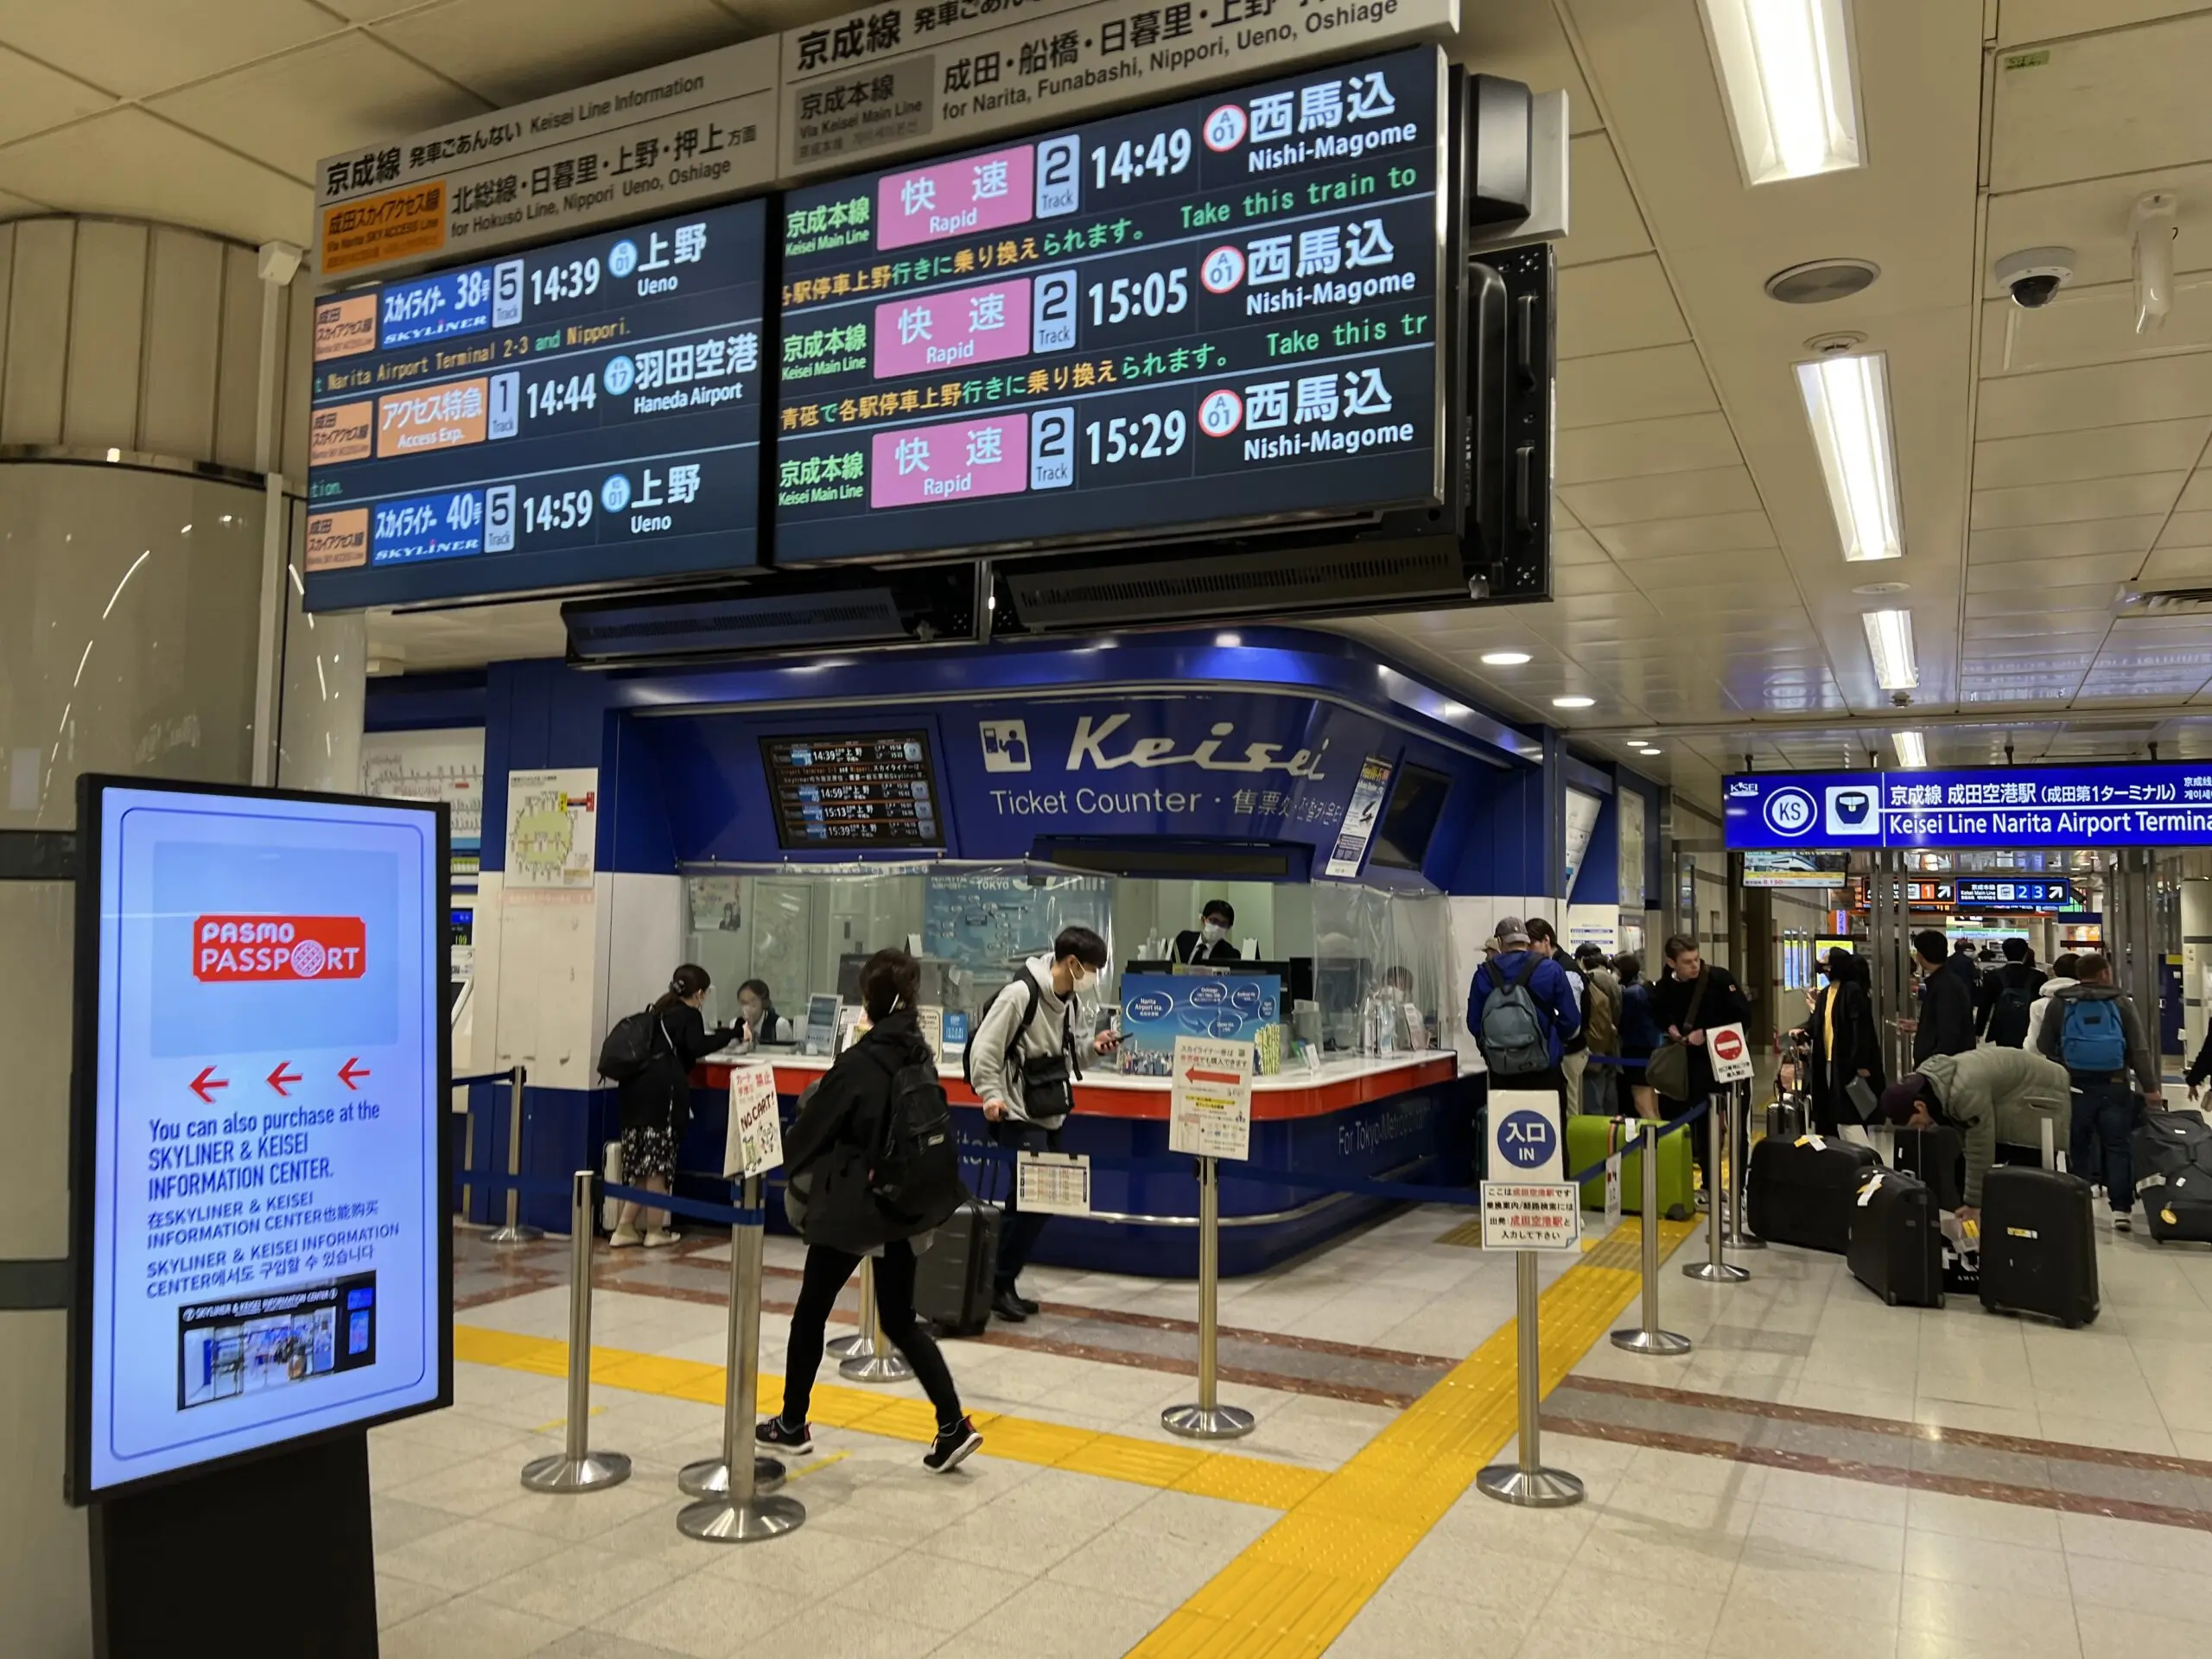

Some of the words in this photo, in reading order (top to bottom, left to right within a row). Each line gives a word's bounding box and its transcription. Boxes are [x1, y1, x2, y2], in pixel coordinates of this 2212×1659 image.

[798, 10, 901, 71] 京成線
[942, 100, 968, 120] for
[973, 87, 1032, 114] Narita,
[1038, 57, 1143, 99] Funabashi,
[1149, 36, 1229, 72] Nippori,
[1236, 22, 1297, 51] Ueno,
[1306, 0, 1398, 33] Oshiage
[531, 107, 574, 133] Keisei
[579, 99, 610, 121] Line
[614, 75, 704, 112] Information
[800, 73, 894, 120] 京成本線
[862, 107, 893, 124] Main
[895, 101, 923, 117] Line
[1249, 71, 1395, 143] 西馬込
[1212, 124, 1235, 143] 01
[1219, 110, 1230, 123] A
[327, 147, 401, 196] 京成線
[410, 122, 522, 169] 発車ごあんない
[1091, 127, 1192, 190] 14:49
[1248, 120, 1418, 173] Nishi-Magome
[1045, 145, 1071, 187] 2
[328, 188, 441, 236] 成田スカイアクセス線
[451, 219, 469, 238] for
[527, 199, 559, 219] Line,
[622, 175, 664, 197] Ueno,
[669, 159, 731, 186] Oshiage
[1041, 188, 1073, 211] Track
[1180, 201, 1230, 230] Take
[1243, 188, 1294, 217] this
[1306, 173, 1375, 206] train
[1389, 166, 1417, 189] to
[787, 195, 870, 238] 京成本線
[929, 207, 977, 234] Rapid
[638, 222, 707, 272] 上野
[785, 238, 817, 257] Keisei
[817, 232, 843, 252] Main
[845, 227, 870, 246] Line
[1218, 252, 1229, 264] A
[1247, 218, 1395, 287] 西馬込
[499, 268, 517, 301] 5
[531, 257, 601, 305] 14:39
[637, 276, 678, 297] Ueno
[1210, 264, 1234, 285] 01
[384, 284, 446, 324] スカイライナー
[454, 270, 491, 310] 38号
[1042, 279, 1068, 321] 2
[1089, 266, 1188, 327] 15:05
[1246, 270, 1417, 316] Nishi-Magome
[496, 306, 518, 321] Track
[783, 321, 868, 364] 京成本線
[926, 340, 975, 365] Rapid
[1039, 327, 1071, 345] Track
[1266, 329, 1319, 358] Take
[1332, 318, 1386, 346] this
[1401, 313, 1427, 336] tr
[328, 370, 372, 390] Narita
[377, 355, 429, 383] Airport
[435, 341, 495, 369] Terminal
[535, 329, 561, 352] and
[566, 316, 632, 346] Nippori.
[635, 331, 759, 391] 羽田空港
[782, 364, 813, 382] Keisei
[814, 359, 841, 377] Main
[842, 356, 867, 372] Line
[526, 372, 597, 418] 14:44
[610, 370, 627, 388] 17
[780, 343, 1227, 430] 青砥で各駅停車上野行きに乗り換えられます。
[383, 386, 483, 430] アクセス特急
[499, 380, 508, 413] 1
[633, 391, 688, 415] Haneda
[690, 382, 743, 407] Airport
[1216, 395, 1226, 407] A
[1244, 366, 1393, 432] 西馬込
[493, 418, 514, 433] Track
[1208, 407, 1231, 427] 01
[397, 430, 437, 449] Access
[439, 427, 465, 443] Exp.
[1039, 416, 1065, 458] 2
[1086, 409, 1187, 466] 15:29
[1243, 422, 1414, 461] Nishi-Magome
[631, 463, 701, 509] 上野
[779, 451, 864, 488] 京成本線
[924, 473, 972, 499] Rapid
[1036, 463, 1068, 483] Track
[492, 492, 509, 526] 5
[523, 489, 594, 533] 14:59
[779, 489, 810, 506] Keisei
[810, 487, 838, 503] Main
[839, 484, 864, 500] Line
[375, 503, 437, 539] スカイライナー
[446, 493, 483, 531] 40号
[630, 514, 672, 534] Ueno
[488, 531, 512, 546] Track
[813, 750, 836, 762] 14:39
[1065, 713, 1330, 781] Keisei
[821, 787, 843, 799] 14:59
[989, 789, 1069, 816] Ticket
[1076, 788, 1202, 814] Counter
[1891, 785, 1942, 806] 京成線
[1948, 782, 2037, 804] 成田空港駅
[824, 806, 847, 818] 15:13
[1779, 803, 1802, 821] KS
[1890, 814, 1942, 834] Keisei
[1948, 814, 1986, 834] Line
[1993, 812, 2052, 834] Narita
[2056, 811, 2132, 837] Airport
[828, 825, 851, 837] 15:39
[976, 880, 1009, 891] TOKYO
[1924, 886, 1932, 898] 1
[2017, 886, 2028, 899] 2
[2033, 886, 2044, 899] 3
[201, 921, 295, 944] PASMO
[200, 939, 360, 977] PASSPORT
[148, 1117, 180, 1142] You
[186, 1119, 217, 1138] can
[223, 1111, 257, 1135] also
[262, 1105, 334, 1135] purchase
[339, 1103, 354, 1123] at
[357, 1100, 380, 1121] the
[741, 1111, 753, 1133] NO
[1339, 1125, 1353, 1155] For
[1356, 1120, 1379, 1154] Tokyo
[1505, 1122, 1547, 1143] 入口
[148, 1139, 234, 1172] SKYLINER
[239, 1140, 252, 1160] &
[258, 1131, 308, 1158] KEISEI
[1518, 1147, 1535, 1161] IN
[148, 1165, 264, 1202] INFORMATION
[269, 1156, 334, 1185] CENTER.
[1488, 1187, 1572, 1198] ここは成田空港駅です
[148, 1200, 243, 1230] 在SKYLINER
[248, 1198, 262, 1213] &
[266, 1191, 314, 1211] KEISEI
[147, 1217, 260, 1249] INFORMATION
[1502, 1230, 1561, 1241] 入力して下さい
[147, 1250, 226, 1279] SKYLINER
[232, 1247, 245, 1263] &
[251, 1239, 298, 1261] KEISEI
[302, 1222, 399, 1251] INFORMATION
[146, 1263, 255, 1298] CENTER에서도
[259, 1255, 301, 1280] 구입할
[304, 1253, 319, 1271] 수
[322, 1243, 375, 1267] 있습니다
